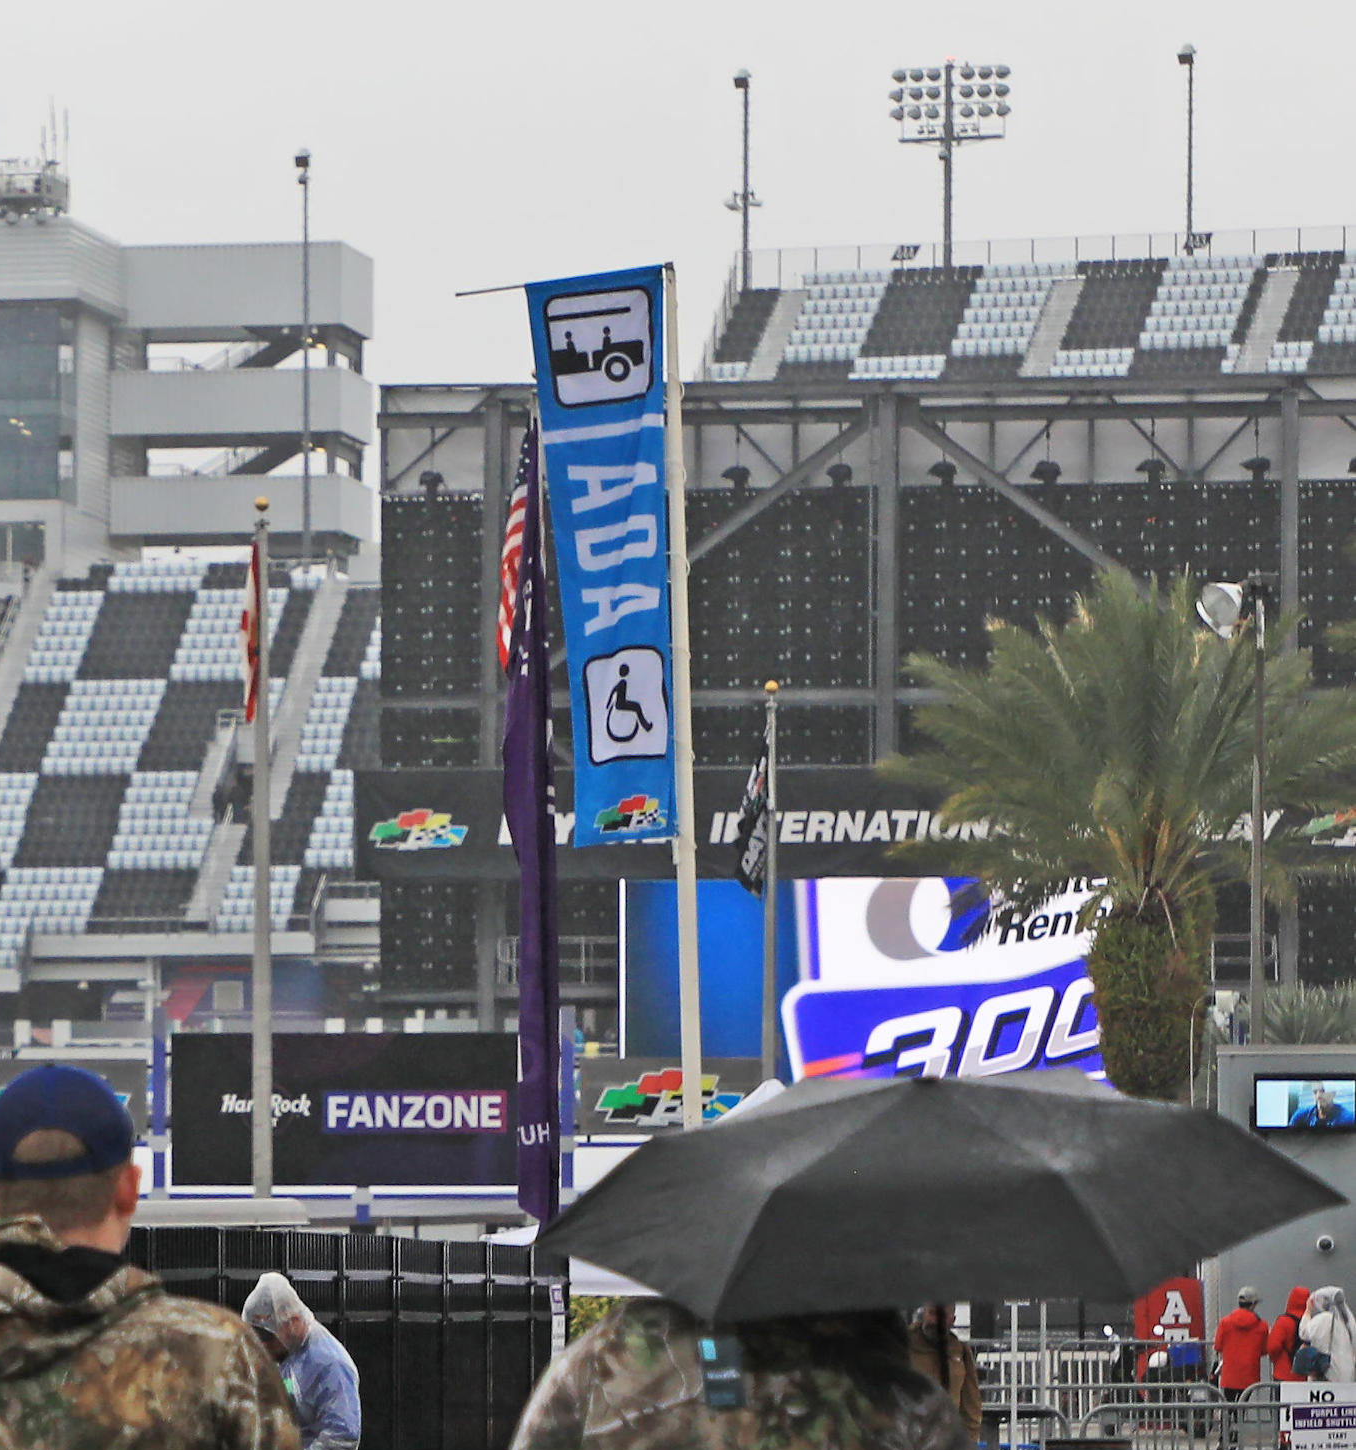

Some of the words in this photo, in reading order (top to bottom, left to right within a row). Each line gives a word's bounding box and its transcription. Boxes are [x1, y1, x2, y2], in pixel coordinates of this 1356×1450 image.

[567, 461, 662, 637] ADA
[709, 809, 1012, 845] IERNATION
[220, 1093, 254, 1113] Har
[270, 1093, 312, 1117] Rock
[328, 1095, 502, 1128] FANZONE
[1160, 1290, 1192, 1325] A
[1310, 1390, 1335, 1403] NO
